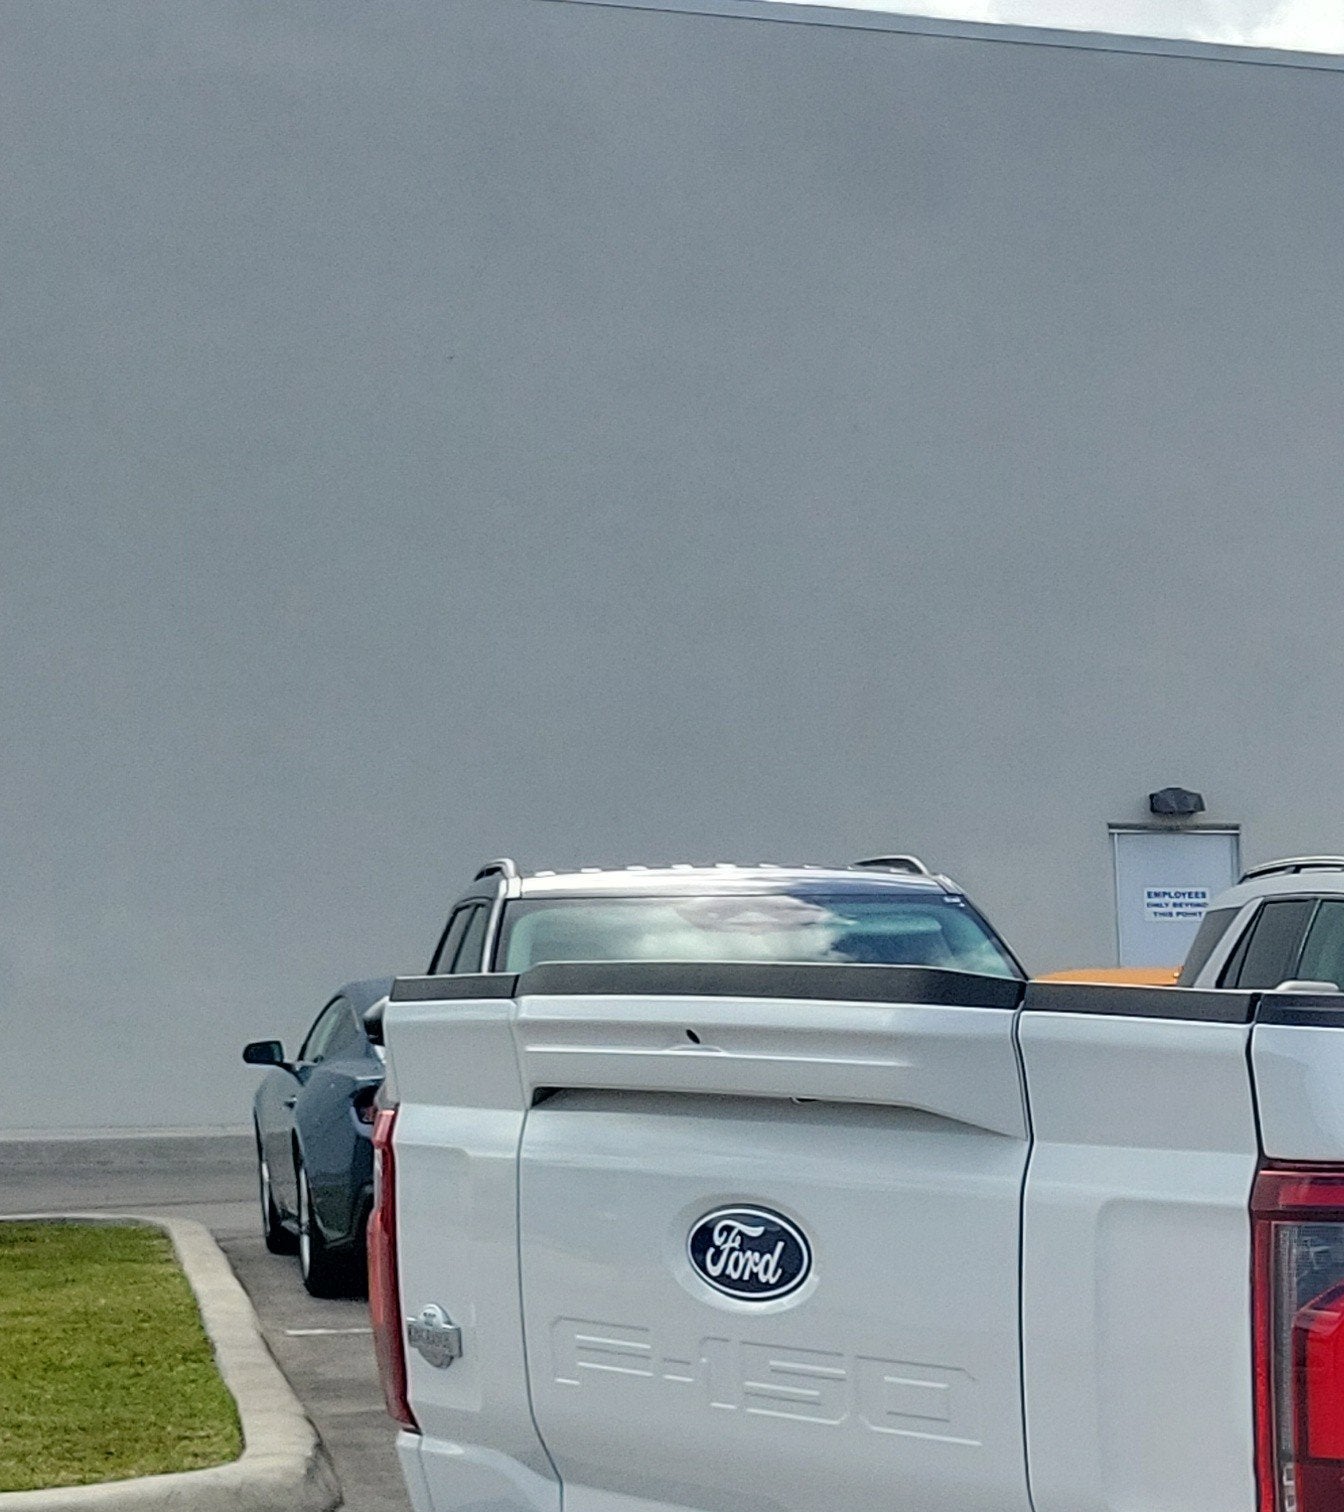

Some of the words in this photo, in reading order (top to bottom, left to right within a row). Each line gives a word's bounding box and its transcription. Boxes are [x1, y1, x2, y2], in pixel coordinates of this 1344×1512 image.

[1146, 891, 1207, 899] EMPLOYEES
[705, 1219, 786, 1285] Ford
[550, 1315, 983, 1447] F-150
